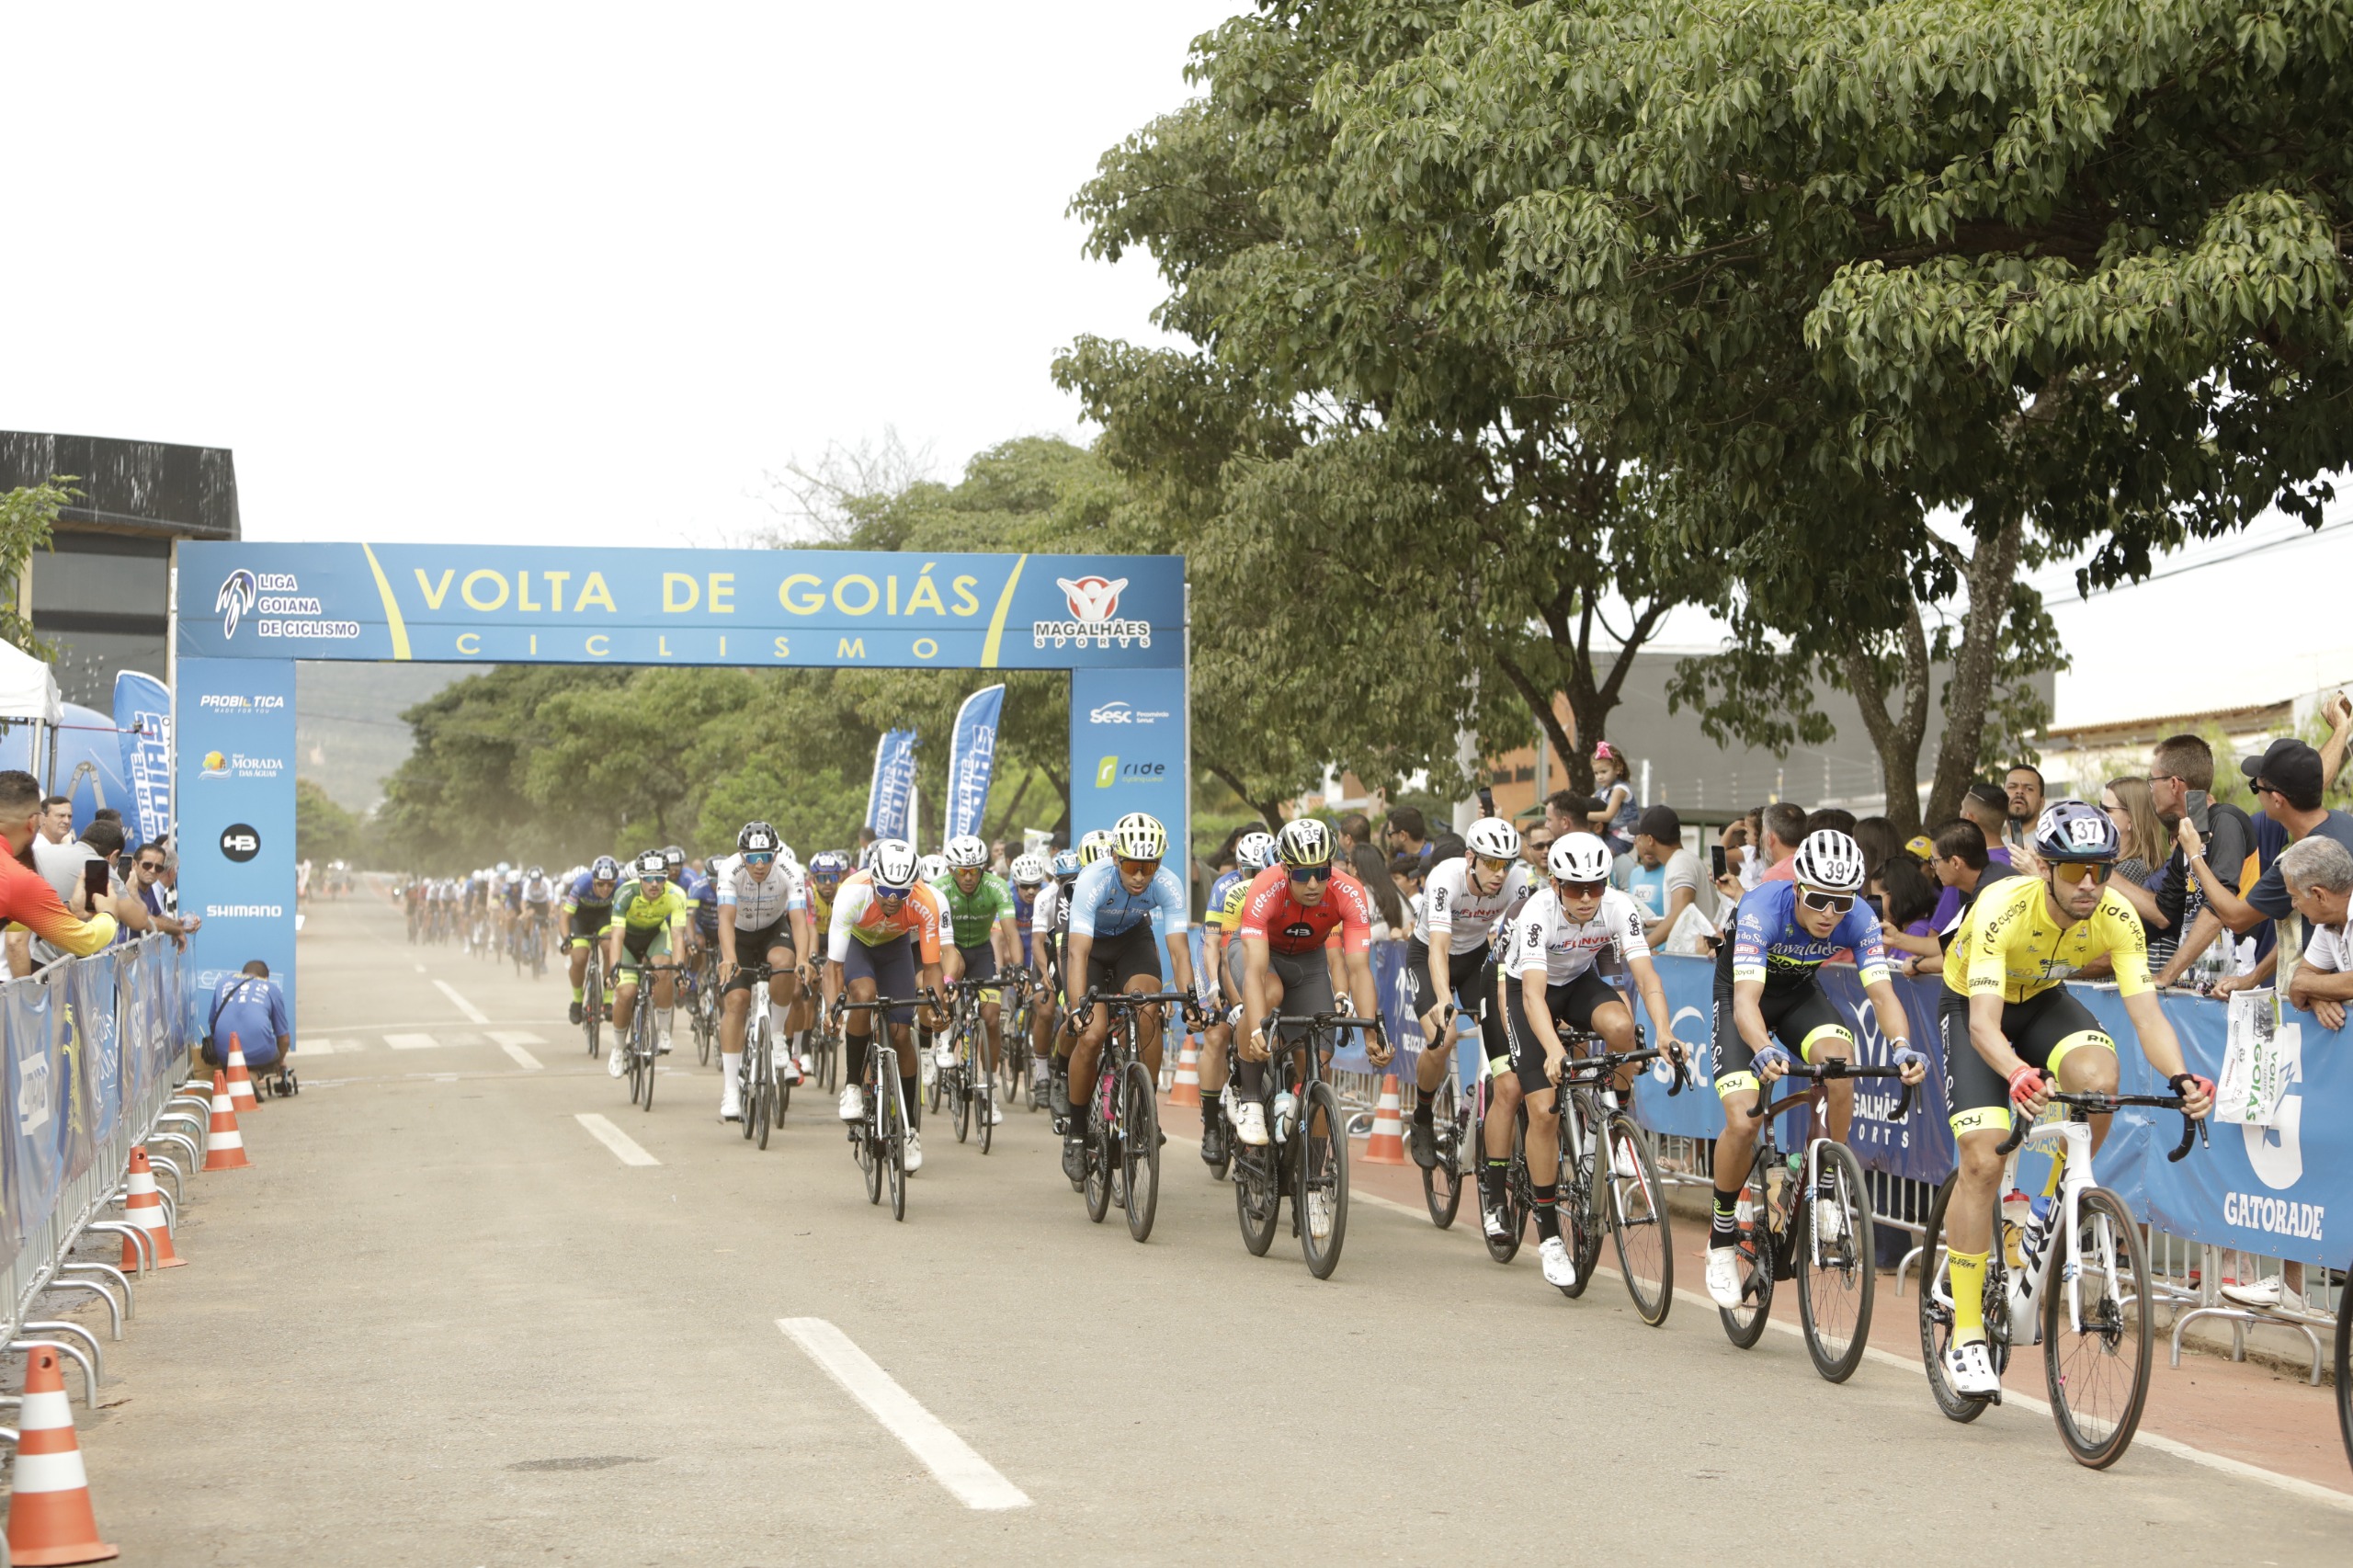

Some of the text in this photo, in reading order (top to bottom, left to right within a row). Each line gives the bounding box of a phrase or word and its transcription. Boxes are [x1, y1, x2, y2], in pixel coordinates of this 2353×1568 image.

[258, 574, 298, 591] LIGA
[414, 562, 979, 617] VOLTA DE GOIÁS
[258, 597, 322, 615] GOIANA
[258, 620, 360, 639] DE CICLISMO
[1035, 619, 1149, 636] MAGALHÃES
[456, 632, 938, 659] CICLISMO
[1035, 638, 1150, 648] SPORTS
[232, 759, 283, 769] MORADA
[1123, 762, 1165, 775] ride
[1296, 828, 1321, 845] 135
[1501, 824, 1507, 833] 4
[2075, 821, 2097, 840] 37
[754, 835, 766, 846] 12
[965, 853, 977, 864] 58
[1133, 843, 1154, 858] 112
[1585, 853, 1592, 868] 1
[889, 862, 909, 878] 117
[1825, 860, 1845, 880] 39
[1332, 880, 1359, 898] ride
[1085, 888, 1099, 912] ride
[1251, 893, 1267, 918] ride
[1266, 879, 1286, 897] cycling
[1435, 887, 1449, 912] Gelog
[207, 905, 282, 917] SHIMANO
[2100, 903, 2130, 922] ide
[1528, 923, 1542, 948] Gelog
[1741, 931, 1751, 940] do
[1984, 900, 2027, 955] ride cycling
[1736, 945, 1756, 953] ABUS
[1859, 937, 1876, 948] Rio
[2246, 1043, 2262, 1122] GOIÁS
[2269, 1051, 2279, 1101] VOLTA
[2224, 1192, 2324, 1241] GATORADE
